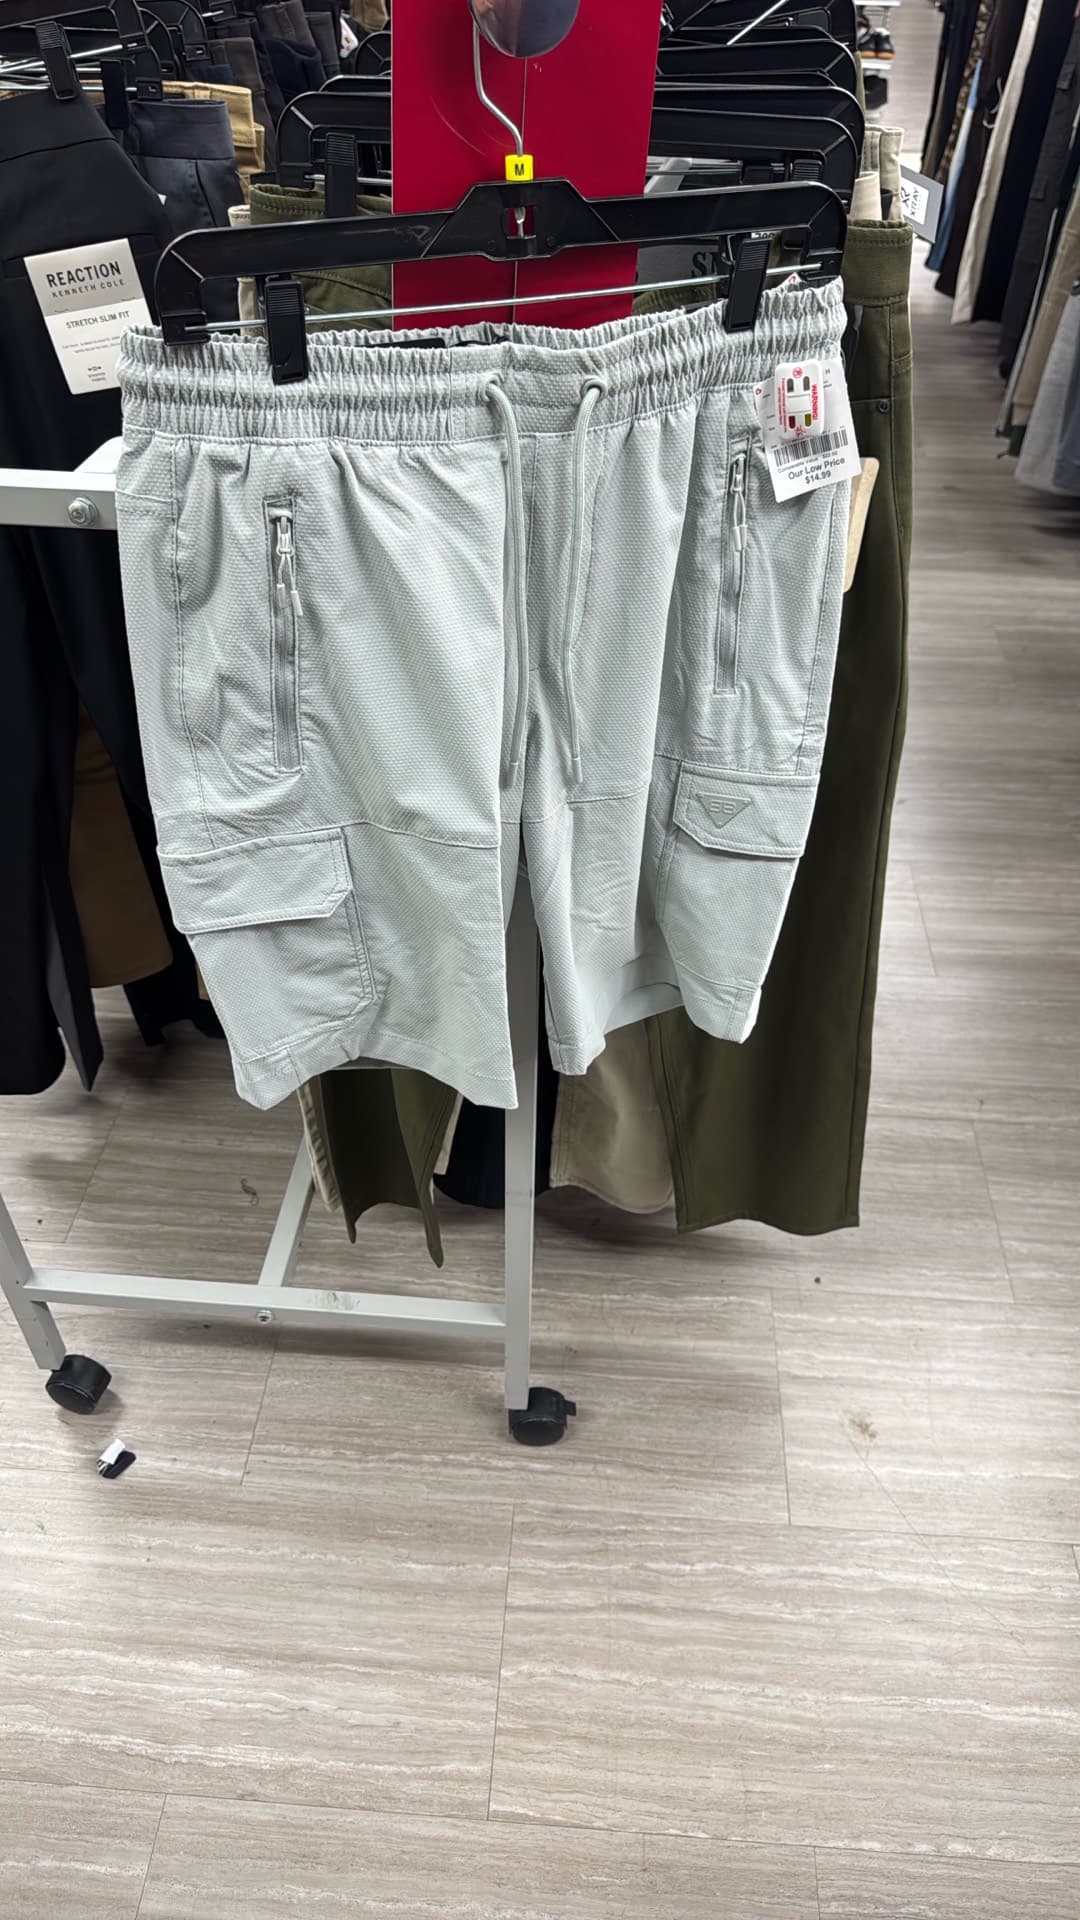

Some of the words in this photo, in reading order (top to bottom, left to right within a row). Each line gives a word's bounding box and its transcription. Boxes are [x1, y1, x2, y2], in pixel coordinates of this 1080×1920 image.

[514, 163, 525, 177] M
[46, 261, 122, 288] REACTION
[52, 284, 97, 298] KENNETH
[100, 278, 126, 289] COLE
[65, 317, 98, 329] STRETCH
[98, 313, 117, 323] SLIM
[118, 310, 130, 319] FIT
[788, 469, 804, 480] Our
[804, 463, 822, 474] Low
[823, 457, 846, 469] Price
[804, 470, 832, 484] $14.99
